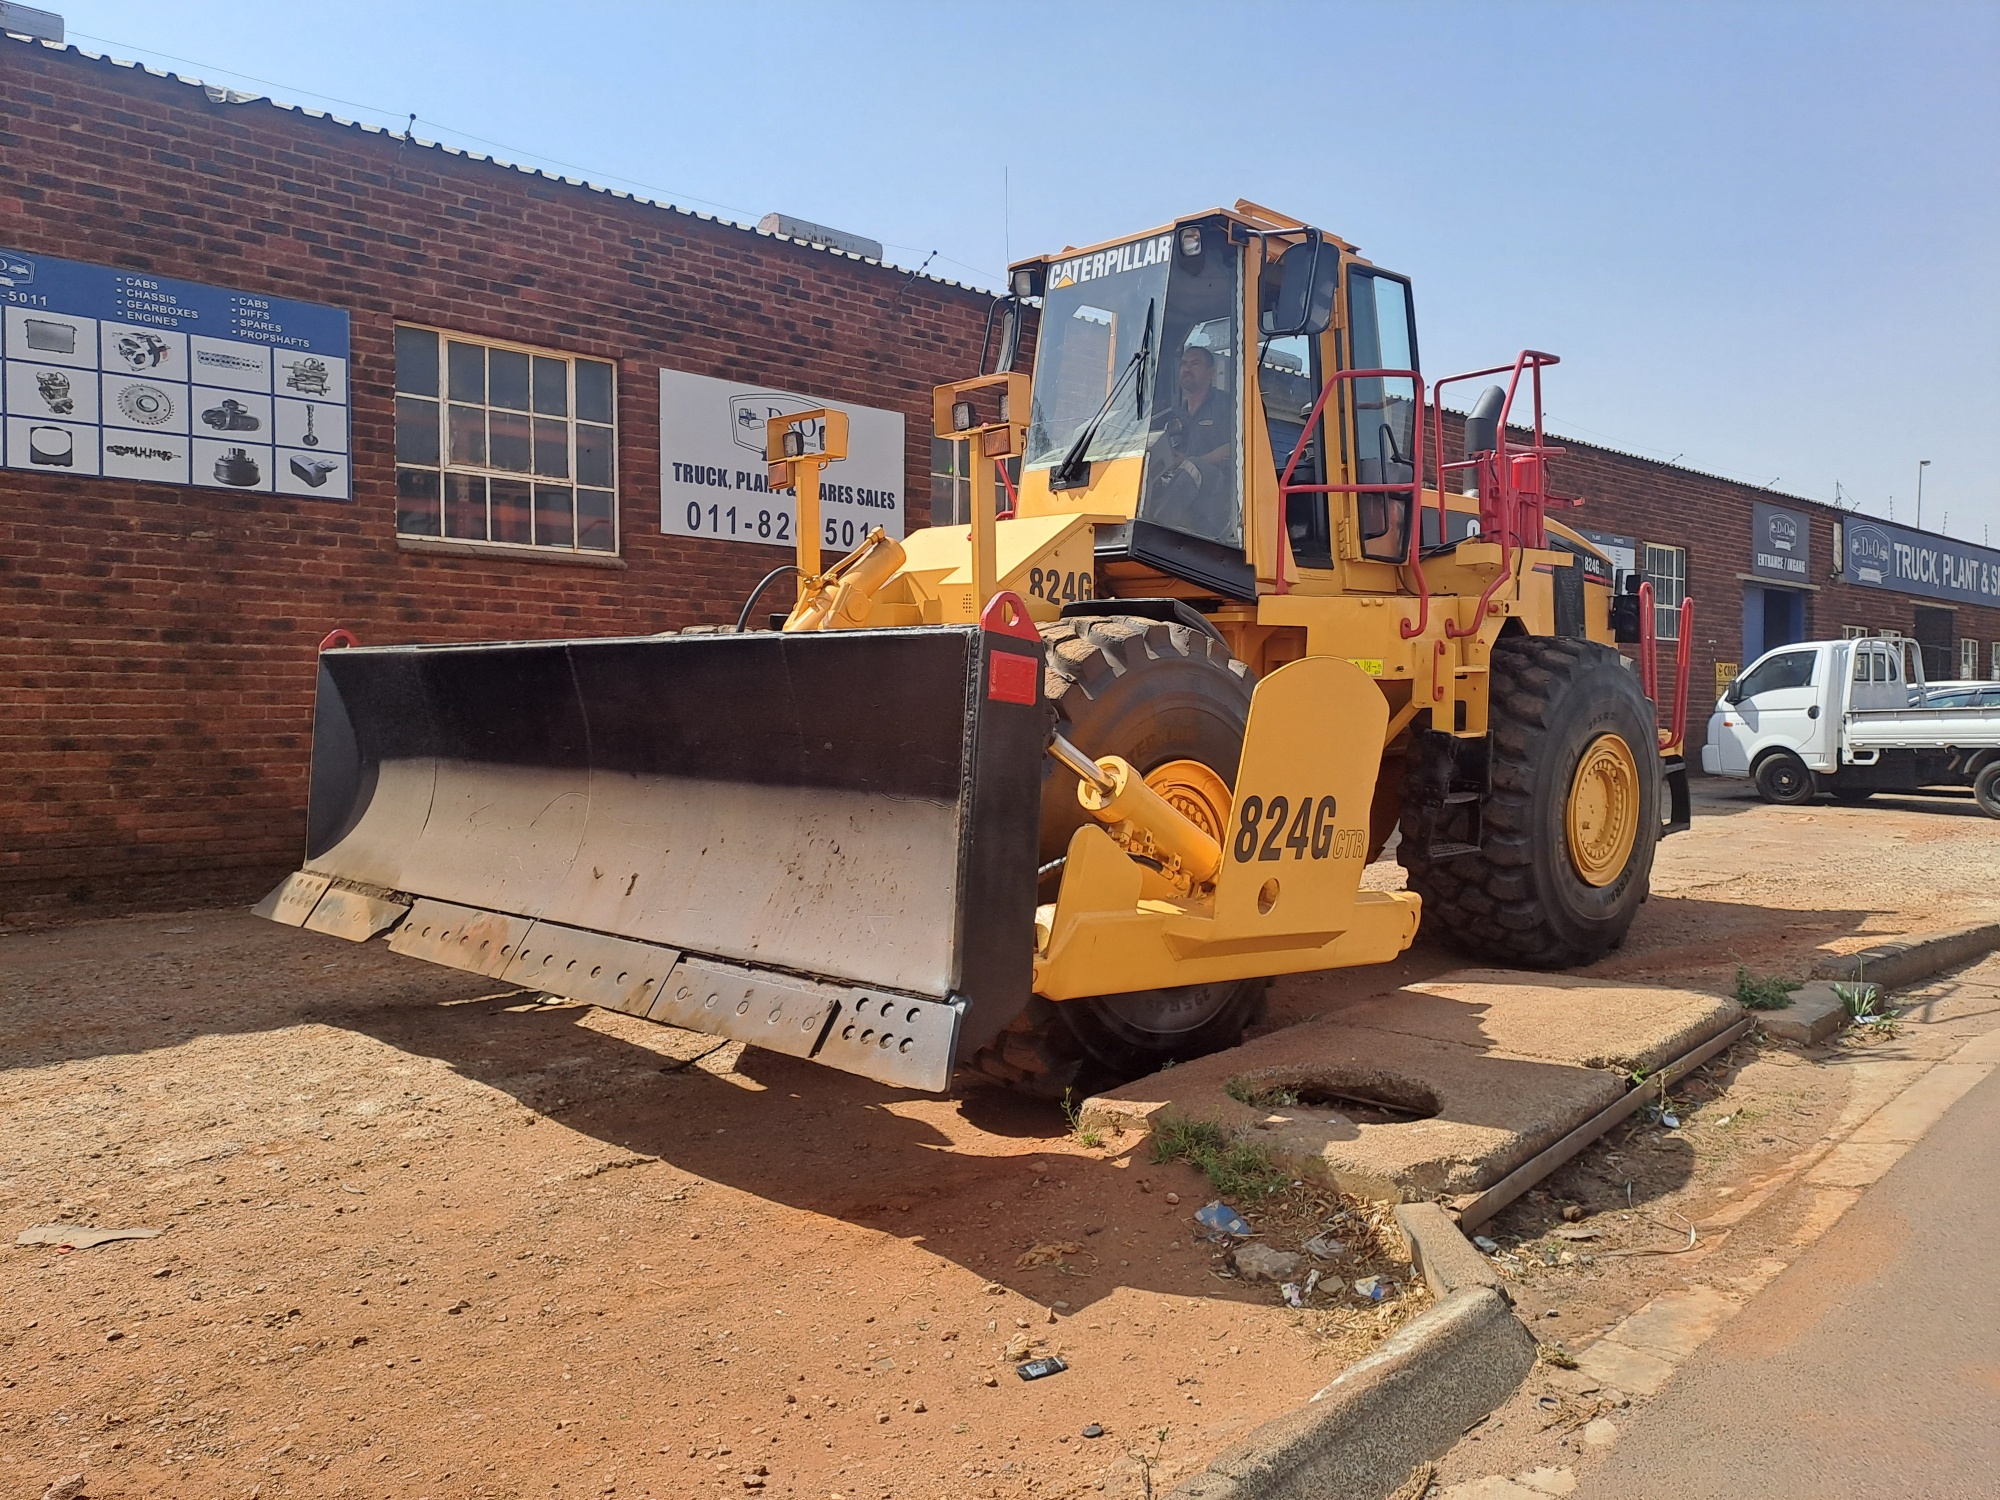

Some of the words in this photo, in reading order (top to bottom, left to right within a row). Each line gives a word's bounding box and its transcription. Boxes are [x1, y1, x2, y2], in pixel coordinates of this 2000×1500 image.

[1049, 235, 1172, 290] CATERPILLAR
[125, 277, 158, 290] CABS
[126, 288, 177, 304] CHASSIS
[239, 297, 269, 310] CABS
[126, 300, 199, 318] GEARBOXES
[239, 308, 270, 321] DIFFS
[127, 310, 178, 327] ENGINES
[240, 319, 282, 333] SPARES
[240, 329, 310, 348] PROPSHAFTS
[672, 462, 732, 490] TRUCK,
[735, 470, 781, 495] PLAN
[857, 488, 896, 510] SALES
[1584, 556, 1600, 575] 824G
[1893, 543, 1940, 589] TRUCK,
[1942, 553, 1980, 592] PLANT
[1980, 562, 1989, 594] &
[1029, 567, 1093, 605] 824G
[1233, 795, 1337, 864] 824G
[1332, 829, 1366, 860] CTR
